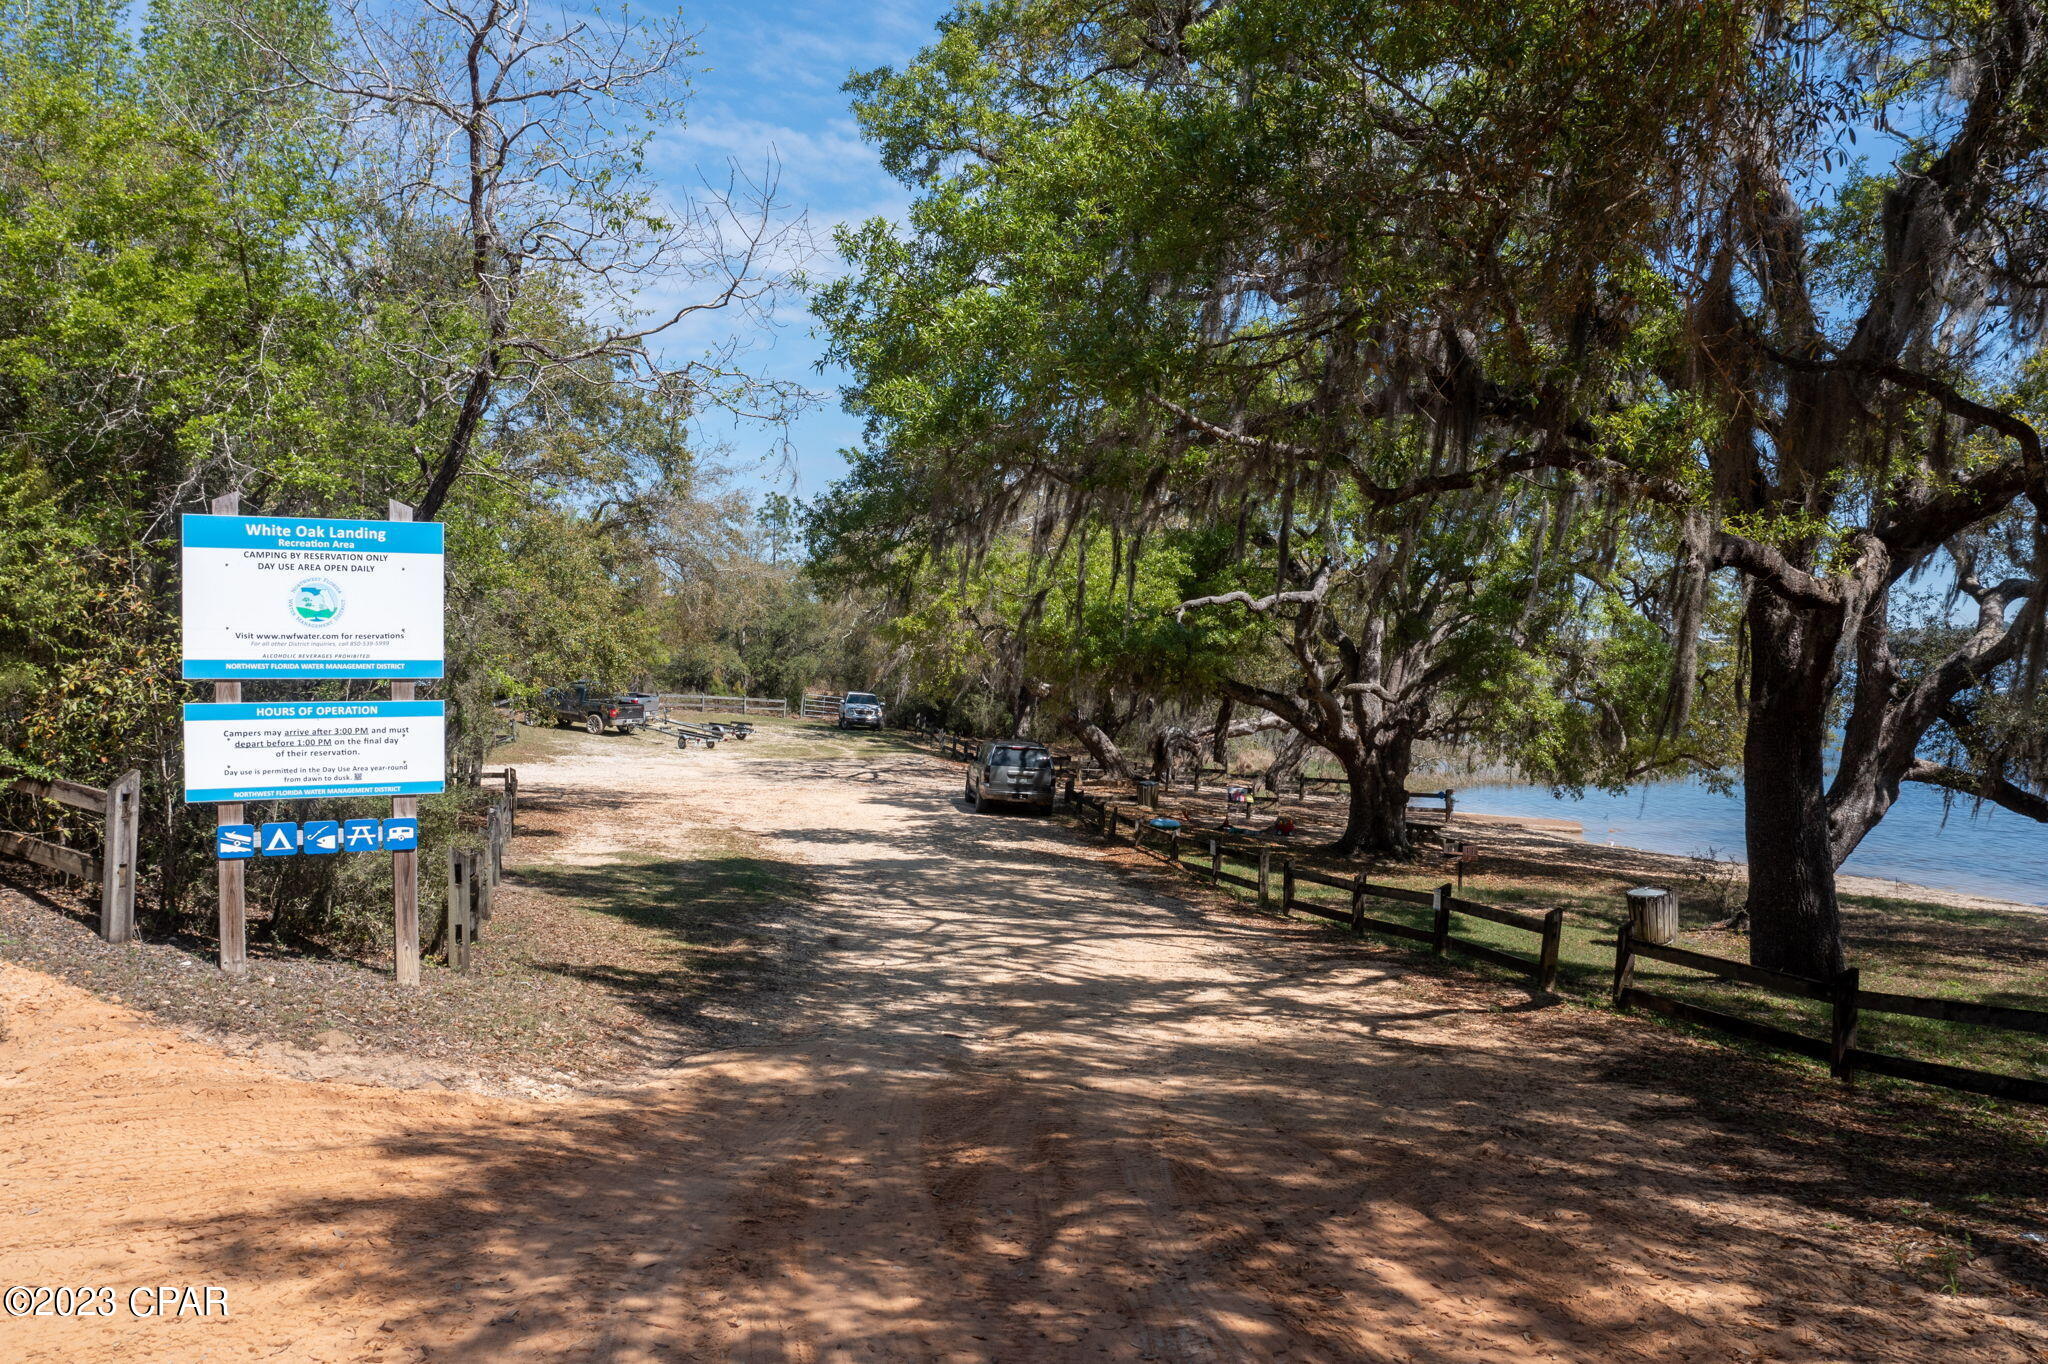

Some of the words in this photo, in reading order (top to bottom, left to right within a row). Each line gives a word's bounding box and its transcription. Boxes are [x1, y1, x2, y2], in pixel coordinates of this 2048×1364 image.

[245, 524, 291, 537] White
[296, 526, 325, 537] Oak
[330, 527, 386, 542] Landing
[279, 539, 331, 548] Recreation
[333, 540, 354, 548] Area
[244, 551, 286, 560] CAMPING
[290, 552, 301, 560] BY
[304, 553, 363, 561] RESERVATION
[257, 632, 339, 640] www.nwfwater.com
[355, 632, 404, 640] reservations
[257, 707, 295, 717] HOURS
[299, 707, 313, 716] OF
[316, 706, 378, 715] OPERATION
[223, 729, 261, 738] Campers
[312, 728, 332, 736] after
[235, 740, 264, 748] depart
[267, 739, 295, 747] before
[347, 737, 361, 745] the
[384, 737, 398, 745] day
[224, 769, 239, 777] Day
[263, 767, 298, 776] permitted
[370, 764, 408, 772] year-round
